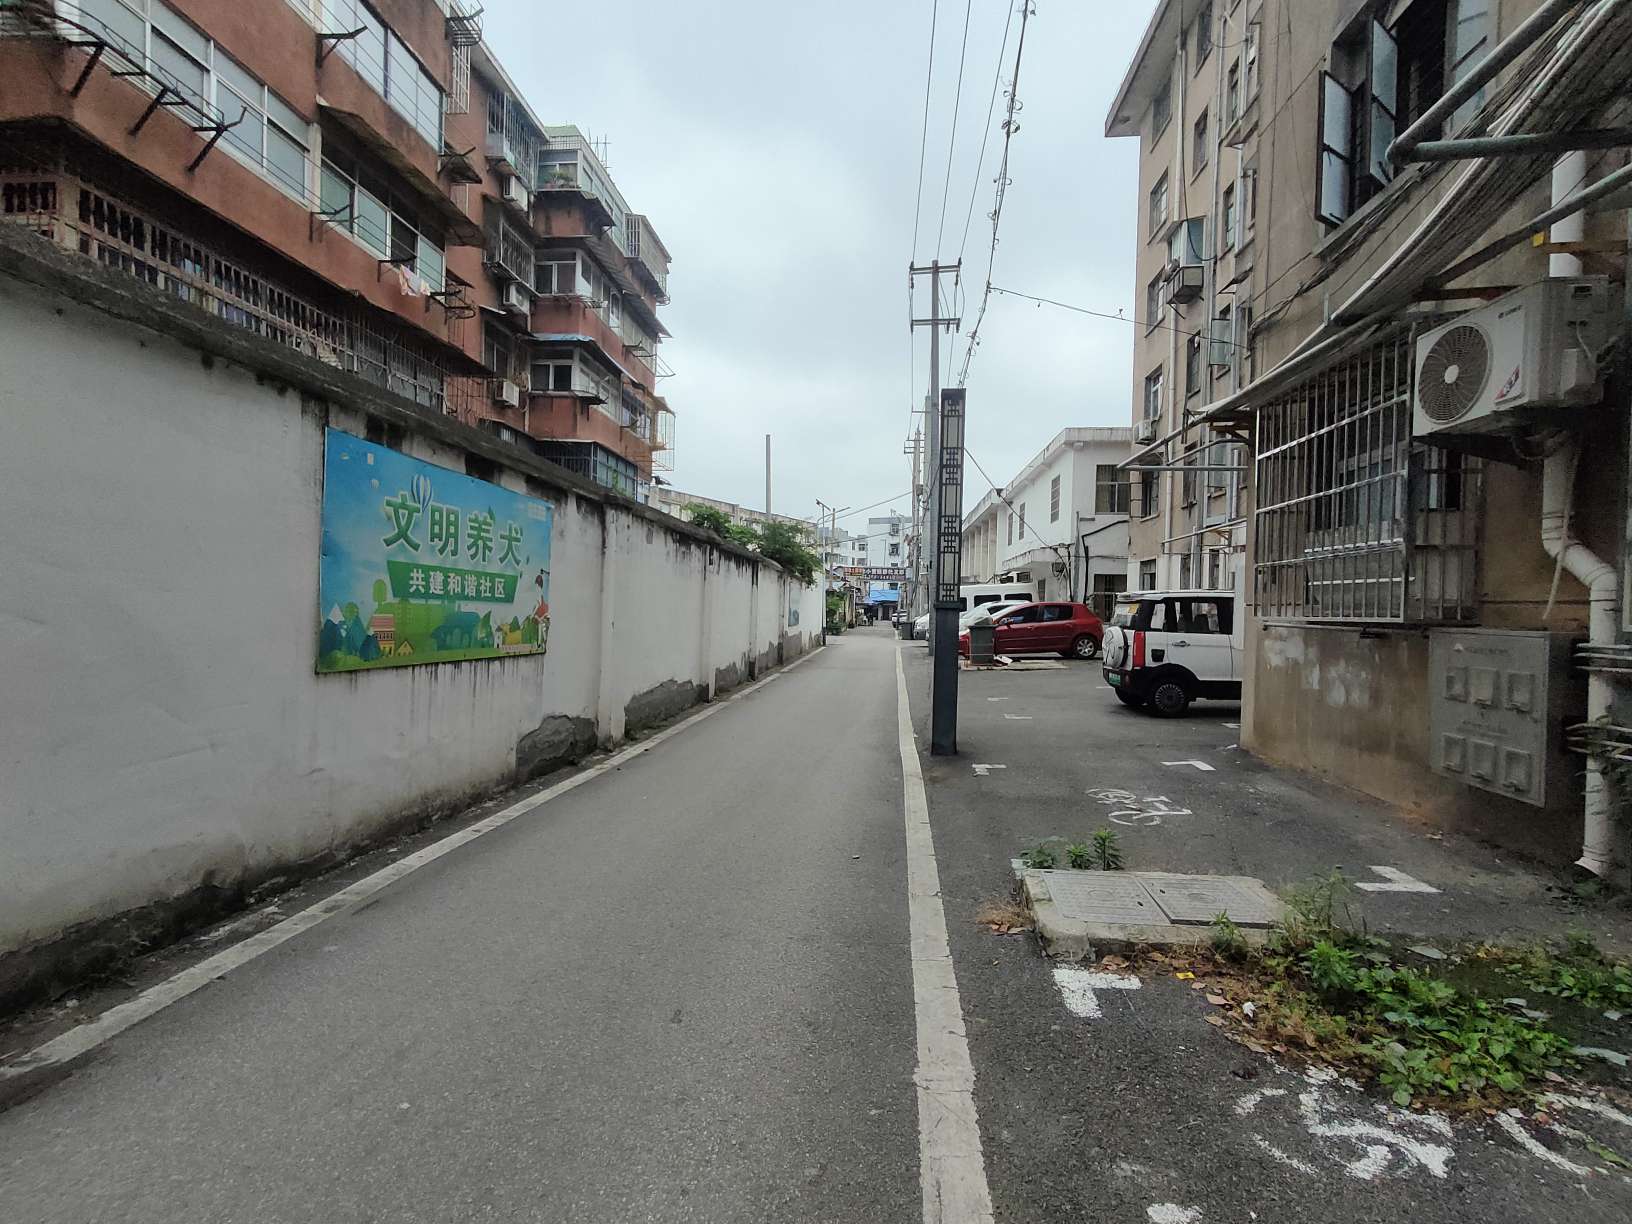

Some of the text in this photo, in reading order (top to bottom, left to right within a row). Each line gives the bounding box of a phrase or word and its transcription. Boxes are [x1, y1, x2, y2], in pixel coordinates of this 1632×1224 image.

[383, 491, 524, 567] 文明养犬
[409, 567, 506, 599] 共建和谐社区
